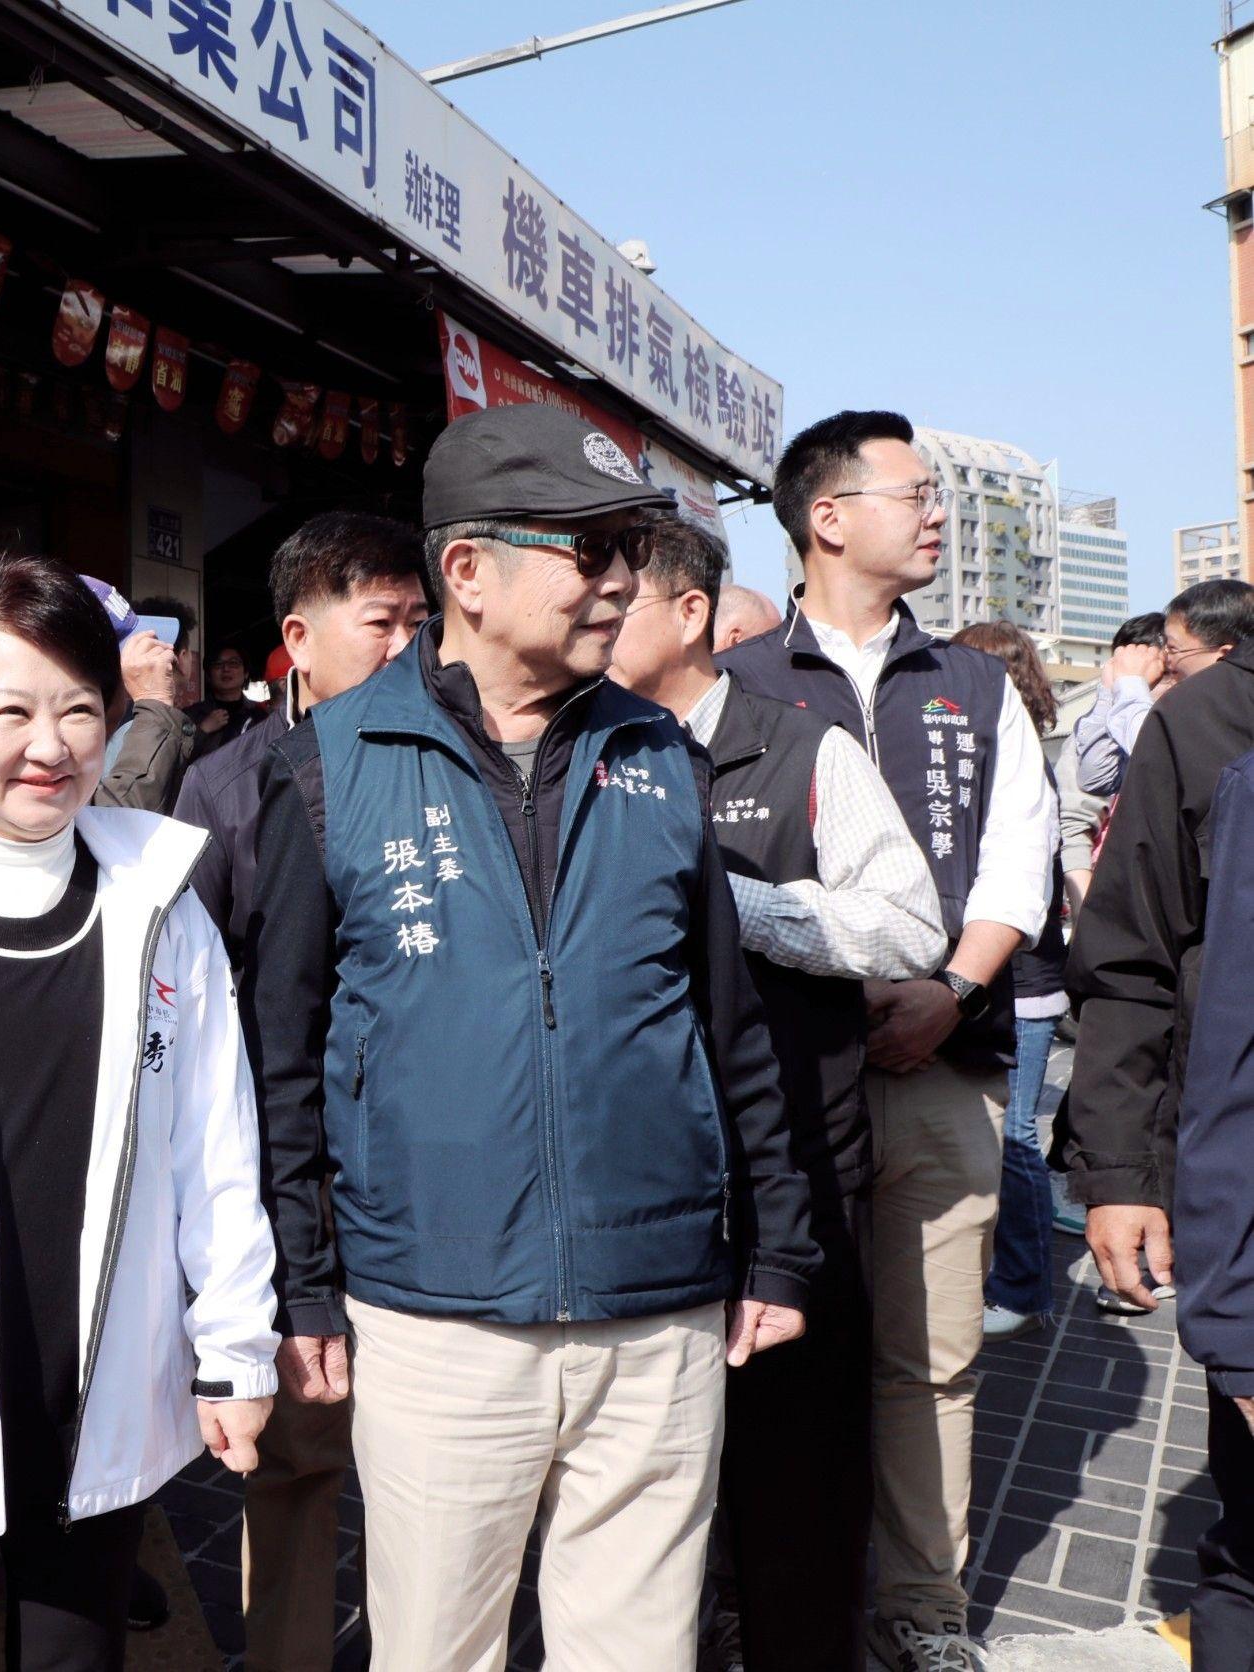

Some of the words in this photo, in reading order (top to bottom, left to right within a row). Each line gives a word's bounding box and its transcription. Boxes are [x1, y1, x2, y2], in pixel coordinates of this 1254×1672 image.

[106, 0, 376, 189] 業公司
[404, 147, 462, 253] 辦理
[501, 176, 776, 466] 機車排氣檢驗站
[157, 533, 180, 560] 421
[956, 732, 977, 808] 運動局
[424, 806, 464, 882] 副主委
[383, 839, 441, 958] 張本椿
